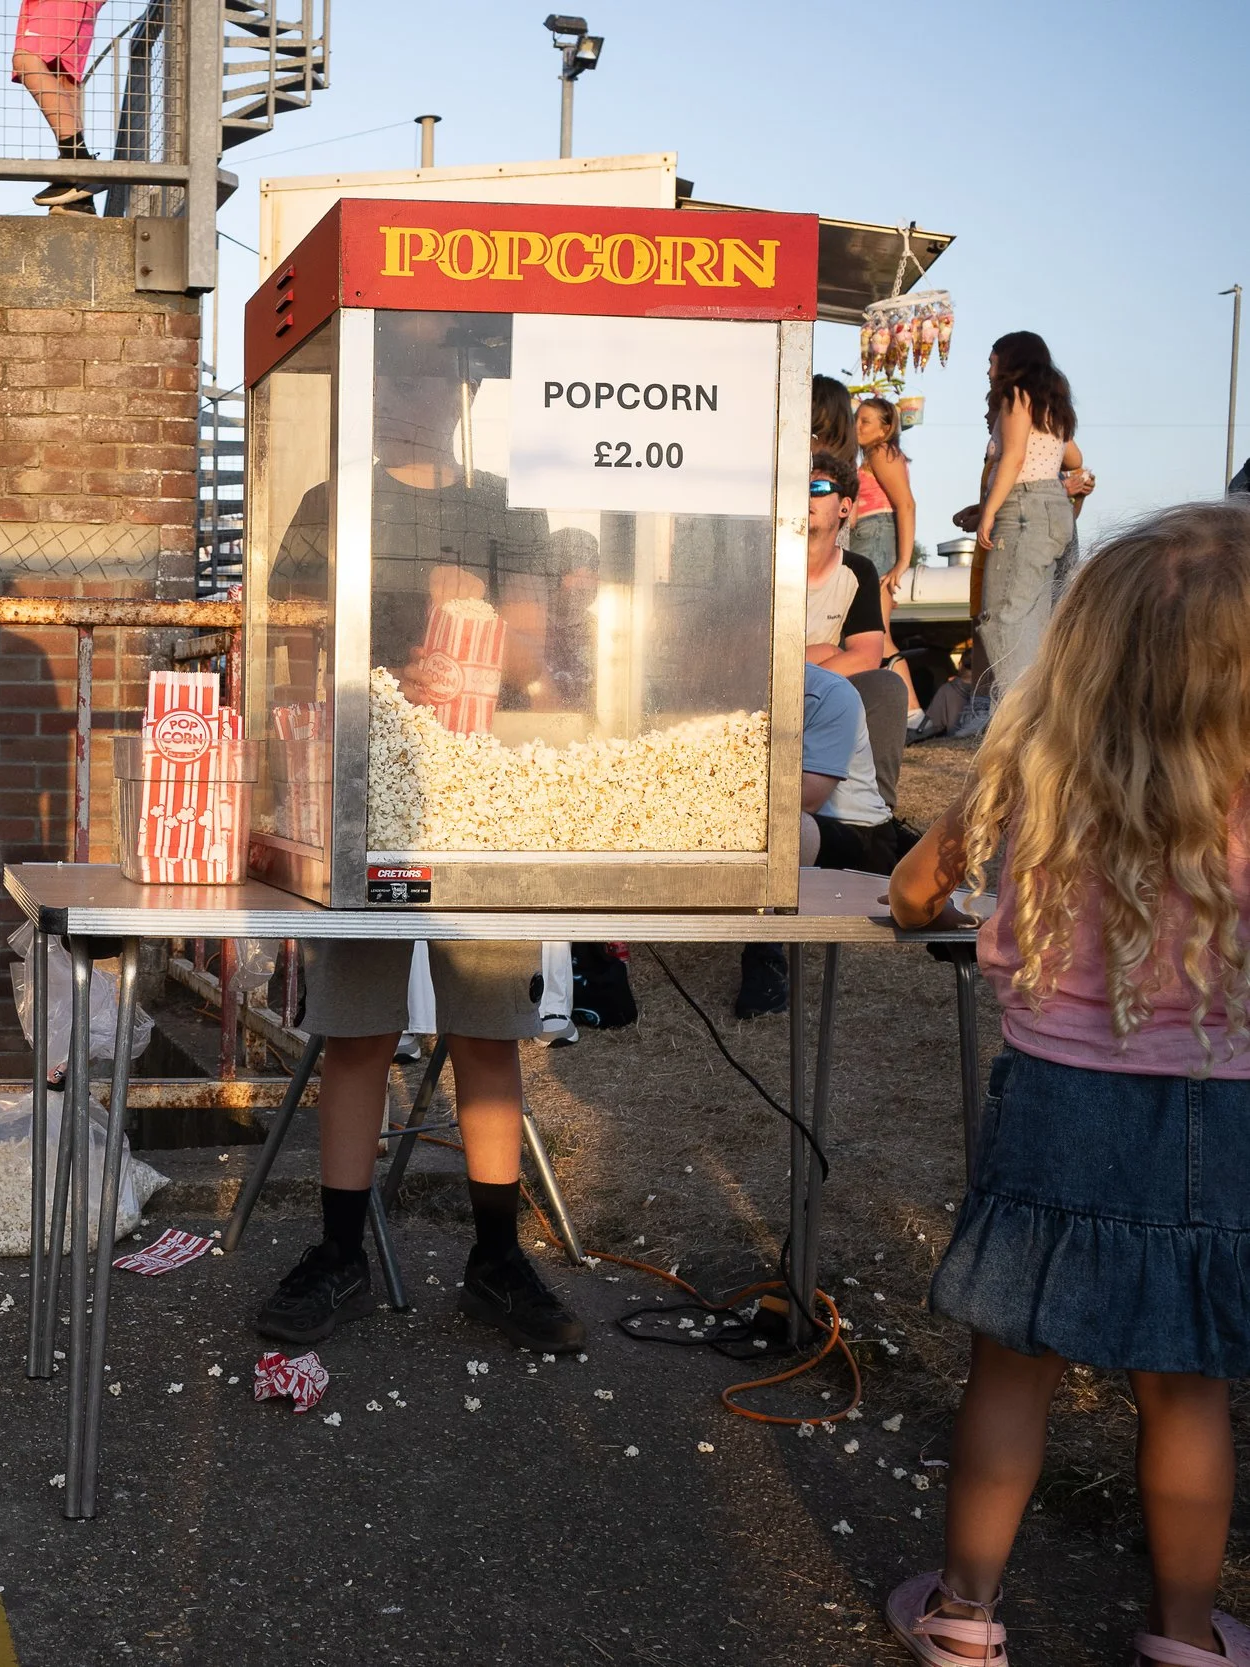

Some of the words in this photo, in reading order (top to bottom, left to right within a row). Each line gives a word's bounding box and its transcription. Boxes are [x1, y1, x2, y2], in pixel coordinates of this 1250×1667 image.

[379, 226, 781, 288] POPCORN
[544, 381, 718, 411] POPCORN
[594, 441, 684, 469] £2.00
[433, 659, 453, 674] POP
[169, 719, 198, 731] POP
[162, 731, 203, 745] CORN
[377, 869, 422, 878] CRETORS
